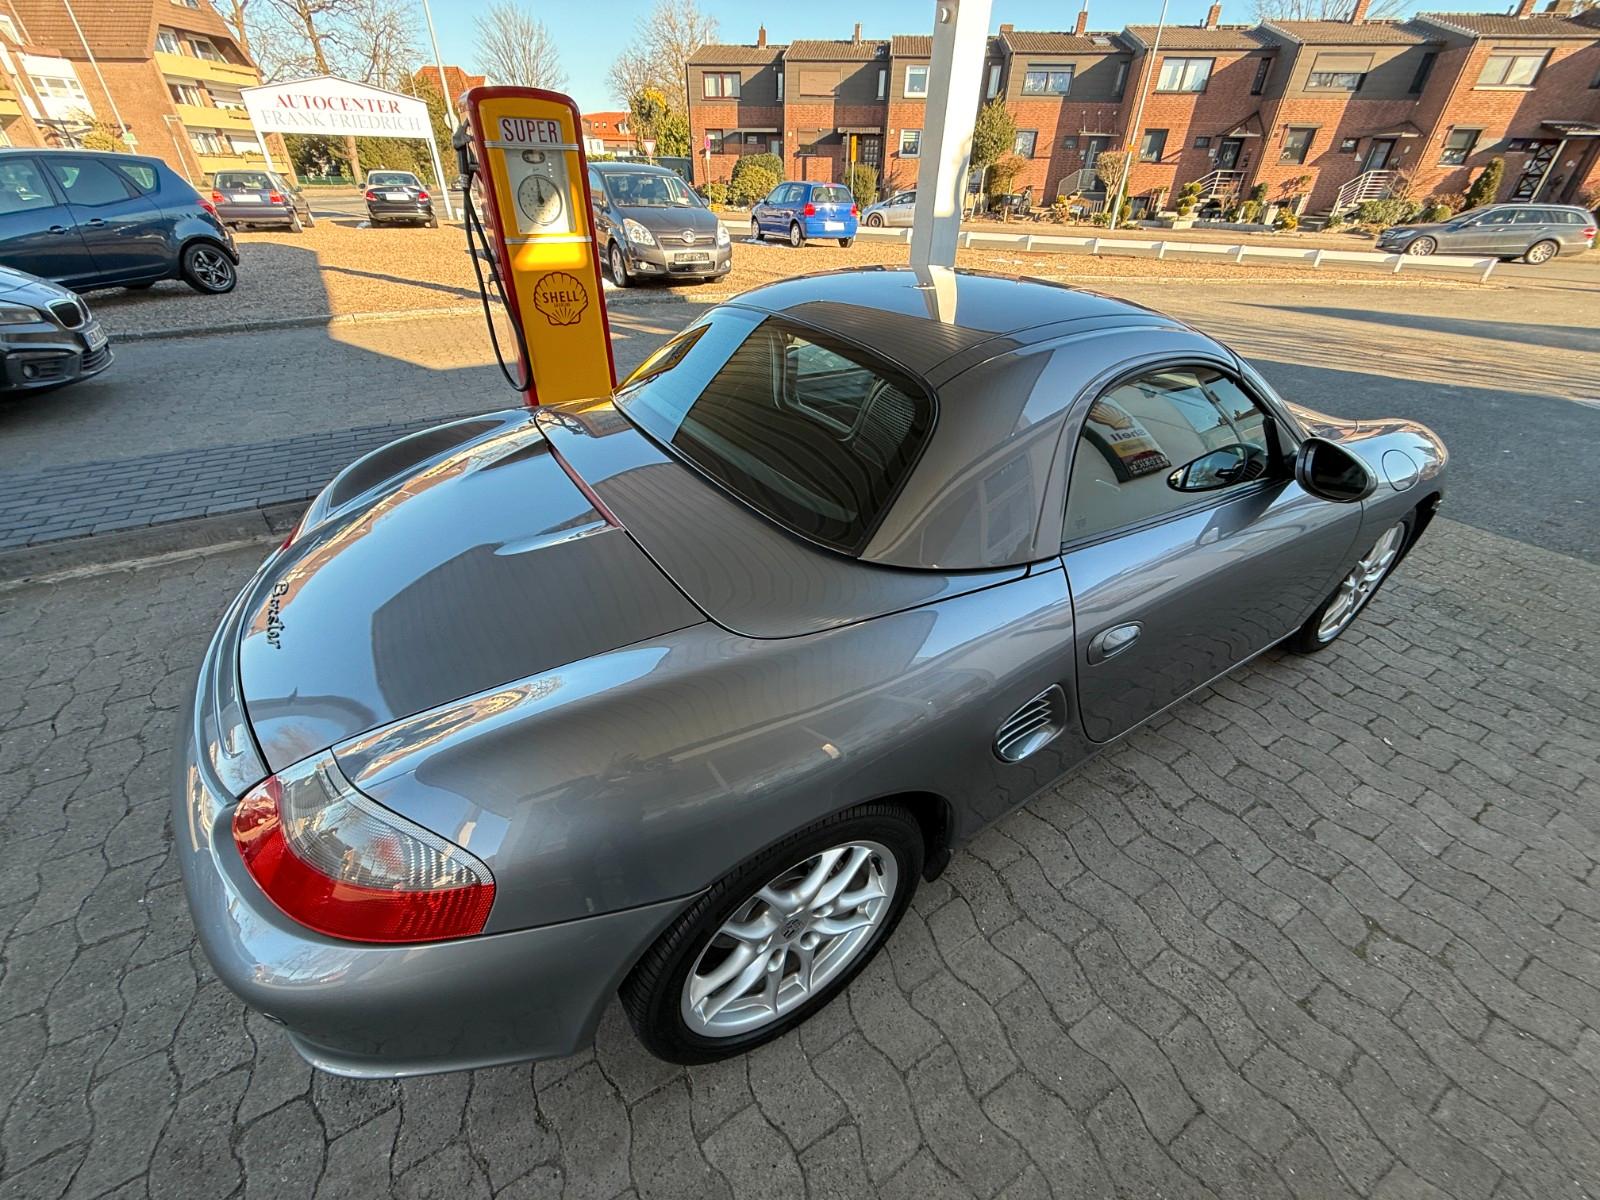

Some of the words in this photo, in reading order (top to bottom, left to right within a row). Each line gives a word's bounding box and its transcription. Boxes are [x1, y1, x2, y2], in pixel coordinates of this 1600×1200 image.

[276, 94, 402, 114] AUTOCENTER
[261, 110, 325, 127] FRANK
[330, 113, 422, 131] FRIEDRICH
[502, 118, 559, 143] SUPER
[542, 290, 580, 304] SHELL
[267, 581, 290, 649] Boxster
